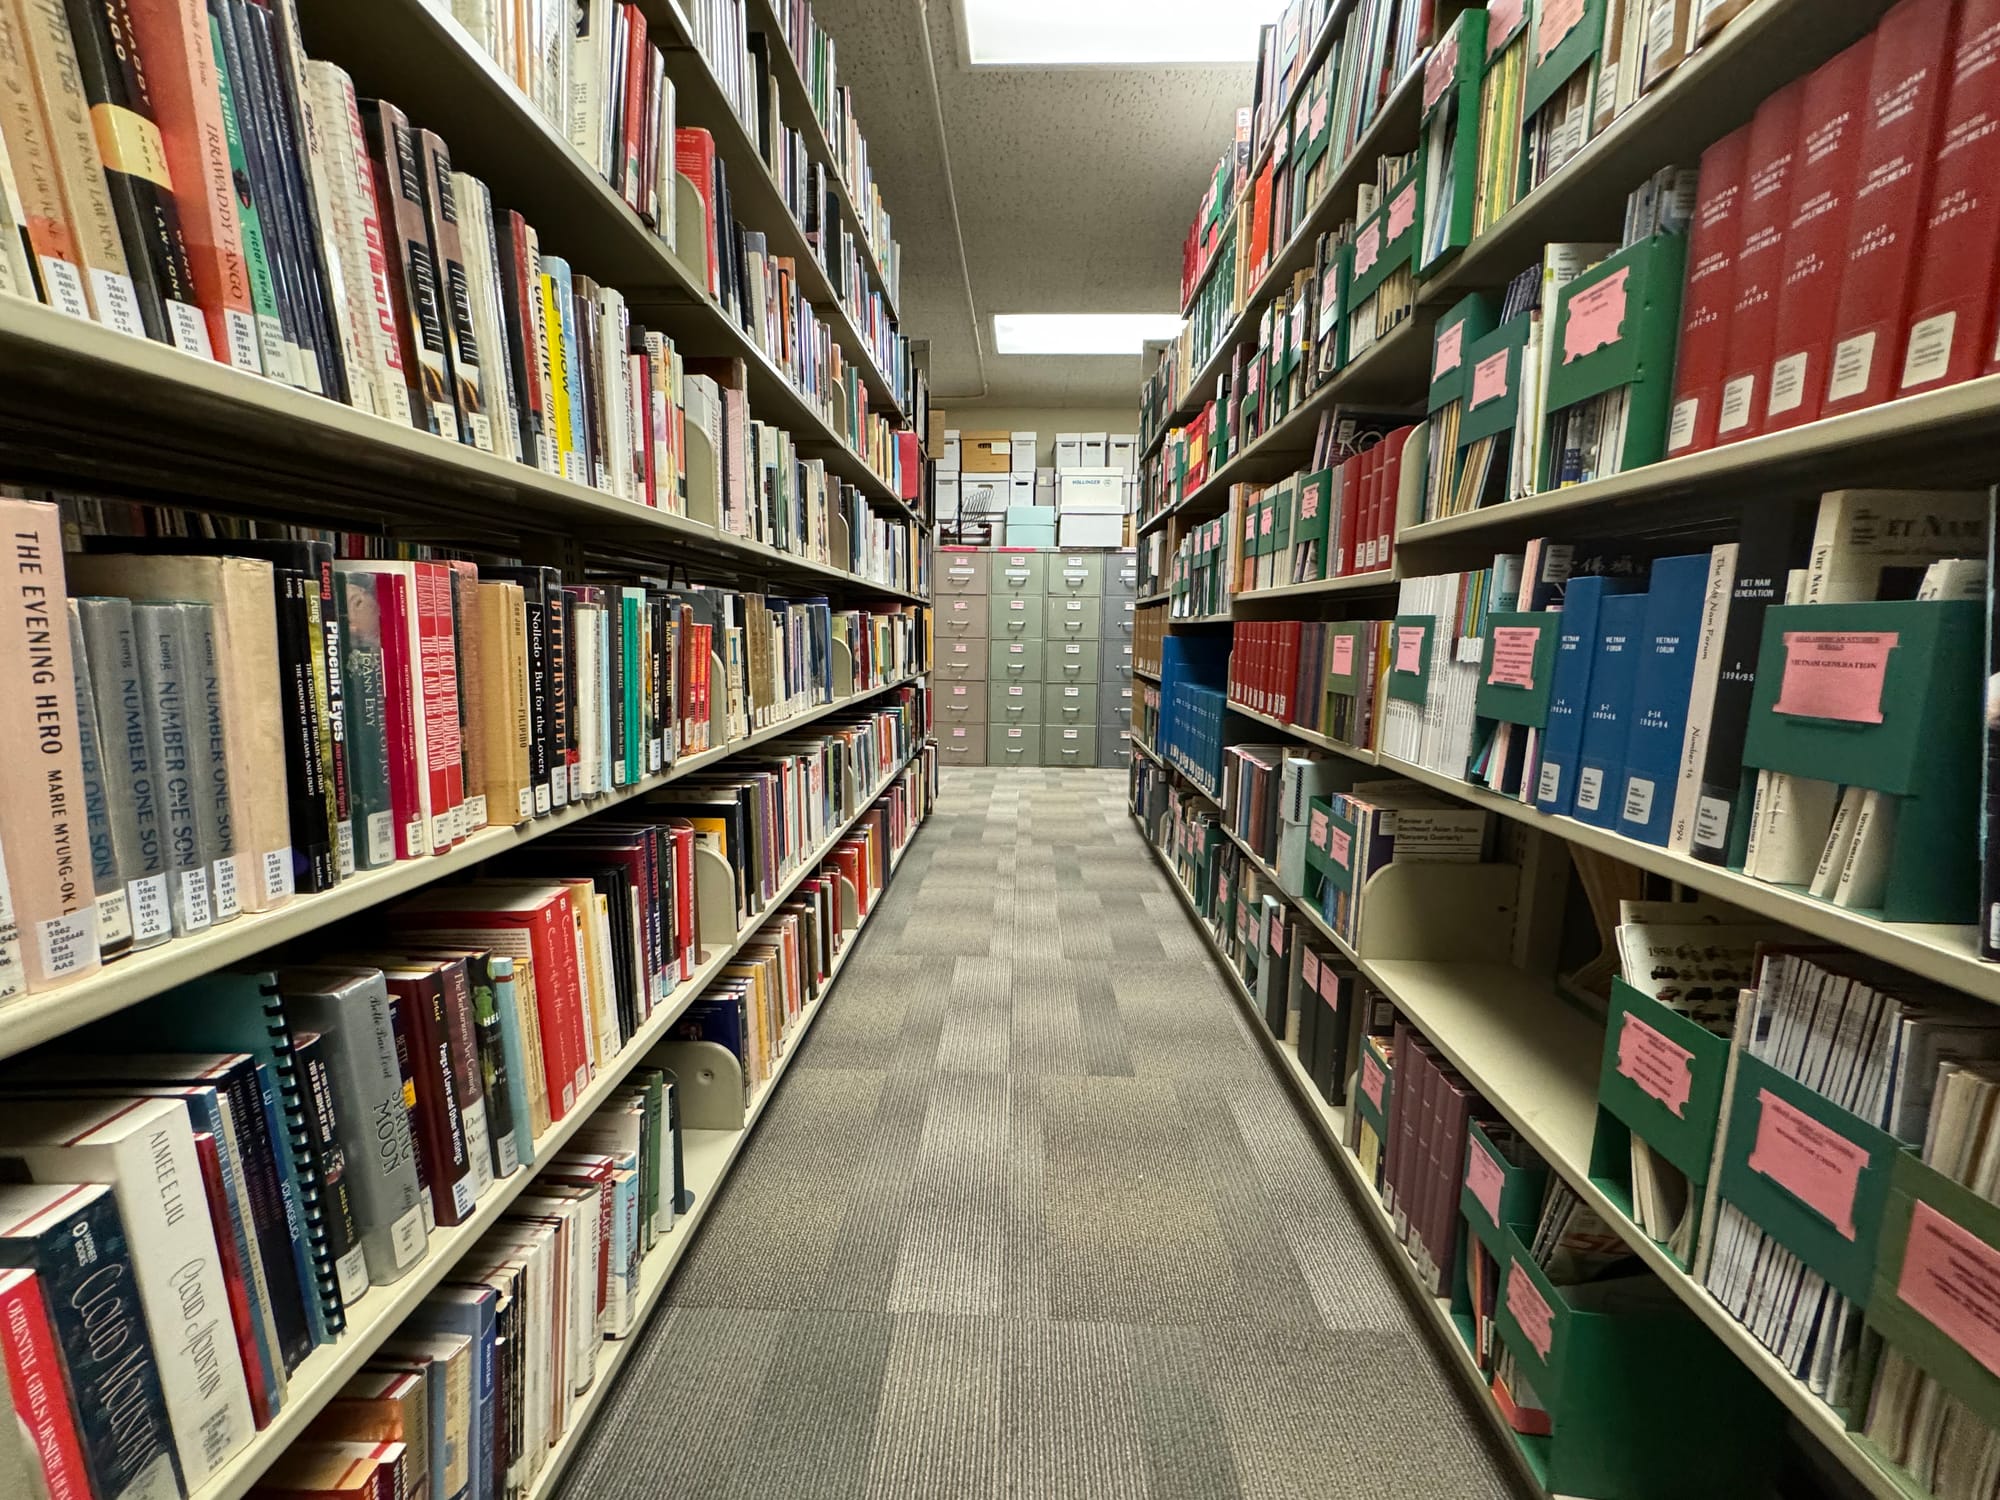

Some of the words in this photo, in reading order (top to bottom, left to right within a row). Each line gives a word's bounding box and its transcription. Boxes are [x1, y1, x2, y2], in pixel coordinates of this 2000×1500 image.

[205, 122, 234, 234] IRRAWADDY
[223, 236, 244, 300] TANGO
[155, 205, 182, 300] LAW-YONE
[176, 230, 195, 291] WENDY
[14, 530, 43, 576] THE
[1814, 549, 1827, 571] VIET
[417, 574, 436, 617] BULOSAN
[435, 575, 450, 617] BULOSAN
[1734, 589, 1774, 597] GENERATION
[1740, 579, 1752, 587] VIET
[21, 584, 55, 686] EVENING
[119, 629, 134, 671] Leong
[158, 633, 173, 671] Leong
[421, 635, 439, 654] THE
[438, 634, 454, 653] THE
[532, 610, 542, 658] Nolledo
[1605, 636, 1626, 645] VIETNAM
[1655, 636, 1680, 645] VIETNAM
[1655, 646, 1675, 654] FORUM
[326, 621, 341, 695] Phoenix
[422, 656, 440, 674] CRY
[439, 655, 455, 672] CRY
[1821, 661, 1877, 669] GENERATION
[307, 677, 316, 711] COUNTRY
[423, 675, 442, 696] AND
[441, 673, 457, 693] AND
[534, 671, 543, 693] But
[551, 600, 567, 756] BITTERSWEET
[301, 713, 307, 724] OF
[311, 712, 318, 724] OF
[328, 700, 346, 743] Eyes
[425, 696, 443, 716] THE
[442, 694, 457, 714] THE
[535, 694, 544, 713] for
[34, 693, 63, 755] HERO
[121, 678, 147, 774] NUMBER
[158, 680, 187, 774] NUMBER
[205, 676, 225, 768] NUMBER
[443, 714, 461, 766] DEDICATION
[536, 715, 545, 733] the
[302, 728, 310, 764] DREAMS
[312, 726, 321, 760] DREAMS
[335, 744, 343, 760] AND
[426, 717, 447, 773] DEDICATION
[537, 736, 546, 775] Lovers
[46, 769, 68, 819] MARIE
[132, 778, 155, 823] ONE
[167, 775, 192, 821] ONE
[213, 769, 230, 814] ONE
[139, 827, 161, 872] SON
[173, 822, 195, 868] SON
[218, 813, 234, 853] SON
[52, 821, 77, 905] MYUNG-OK
[90, 834, 114, 879] SON
[138, 886, 157, 895] 3562
[224, 902, 236, 910] AAS
[47, 920, 61, 929] PS
[142, 909, 159, 918] 1975
[142, 924, 160, 934] AAS
[48, 927, 71, 937] 3562
[52, 952, 75, 963] 2022
[53, 960, 75, 972] AAS
[454, 970, 463, 991] The
[432, 993, 442, 1023] Louie
[456, 991, 468, 1042] Barbarians
[439, 1042, 449, 1066] Pangs
[465, 1042, 473, 1058] Are
[444, 1075, 453, 1098] Love
[466, 1058, 477, 1096] Coming
[262, 1089, 273, 1106] LIU
[208, 1109, 230, 1166] TIMOTHY
[373, 1099, 401, 1177] MOON
[391, 1086, 411, 1162] SPRING
[449, 1110, 458, 1130] Other
[452, 1130, 463, 1167] Writings
[149, 1130, 178, 1183] AIMEE
[164, 1199, 186, 1229] LIU
[280, 1178, 291, 1200] VOX
[603, 1173, 612, 1203] TULE
[283, 1200, 300, 1242] ANGELICA
[74, 1241, 88, 1267] BOOKS
[84, 1228, 98, 1264] WARNER
[169, 1257, 206, 1321] CLOUD
[71, 1263, 129, 1362] CLOUD
[180, 1319, 222, 1400] MOUNTAIN
[7, 1298, 37, 1375] ORIENTAL
[25, 1373, 48, 1421] GIRLS
[37, 1418, 62, 1475] DESIRE
